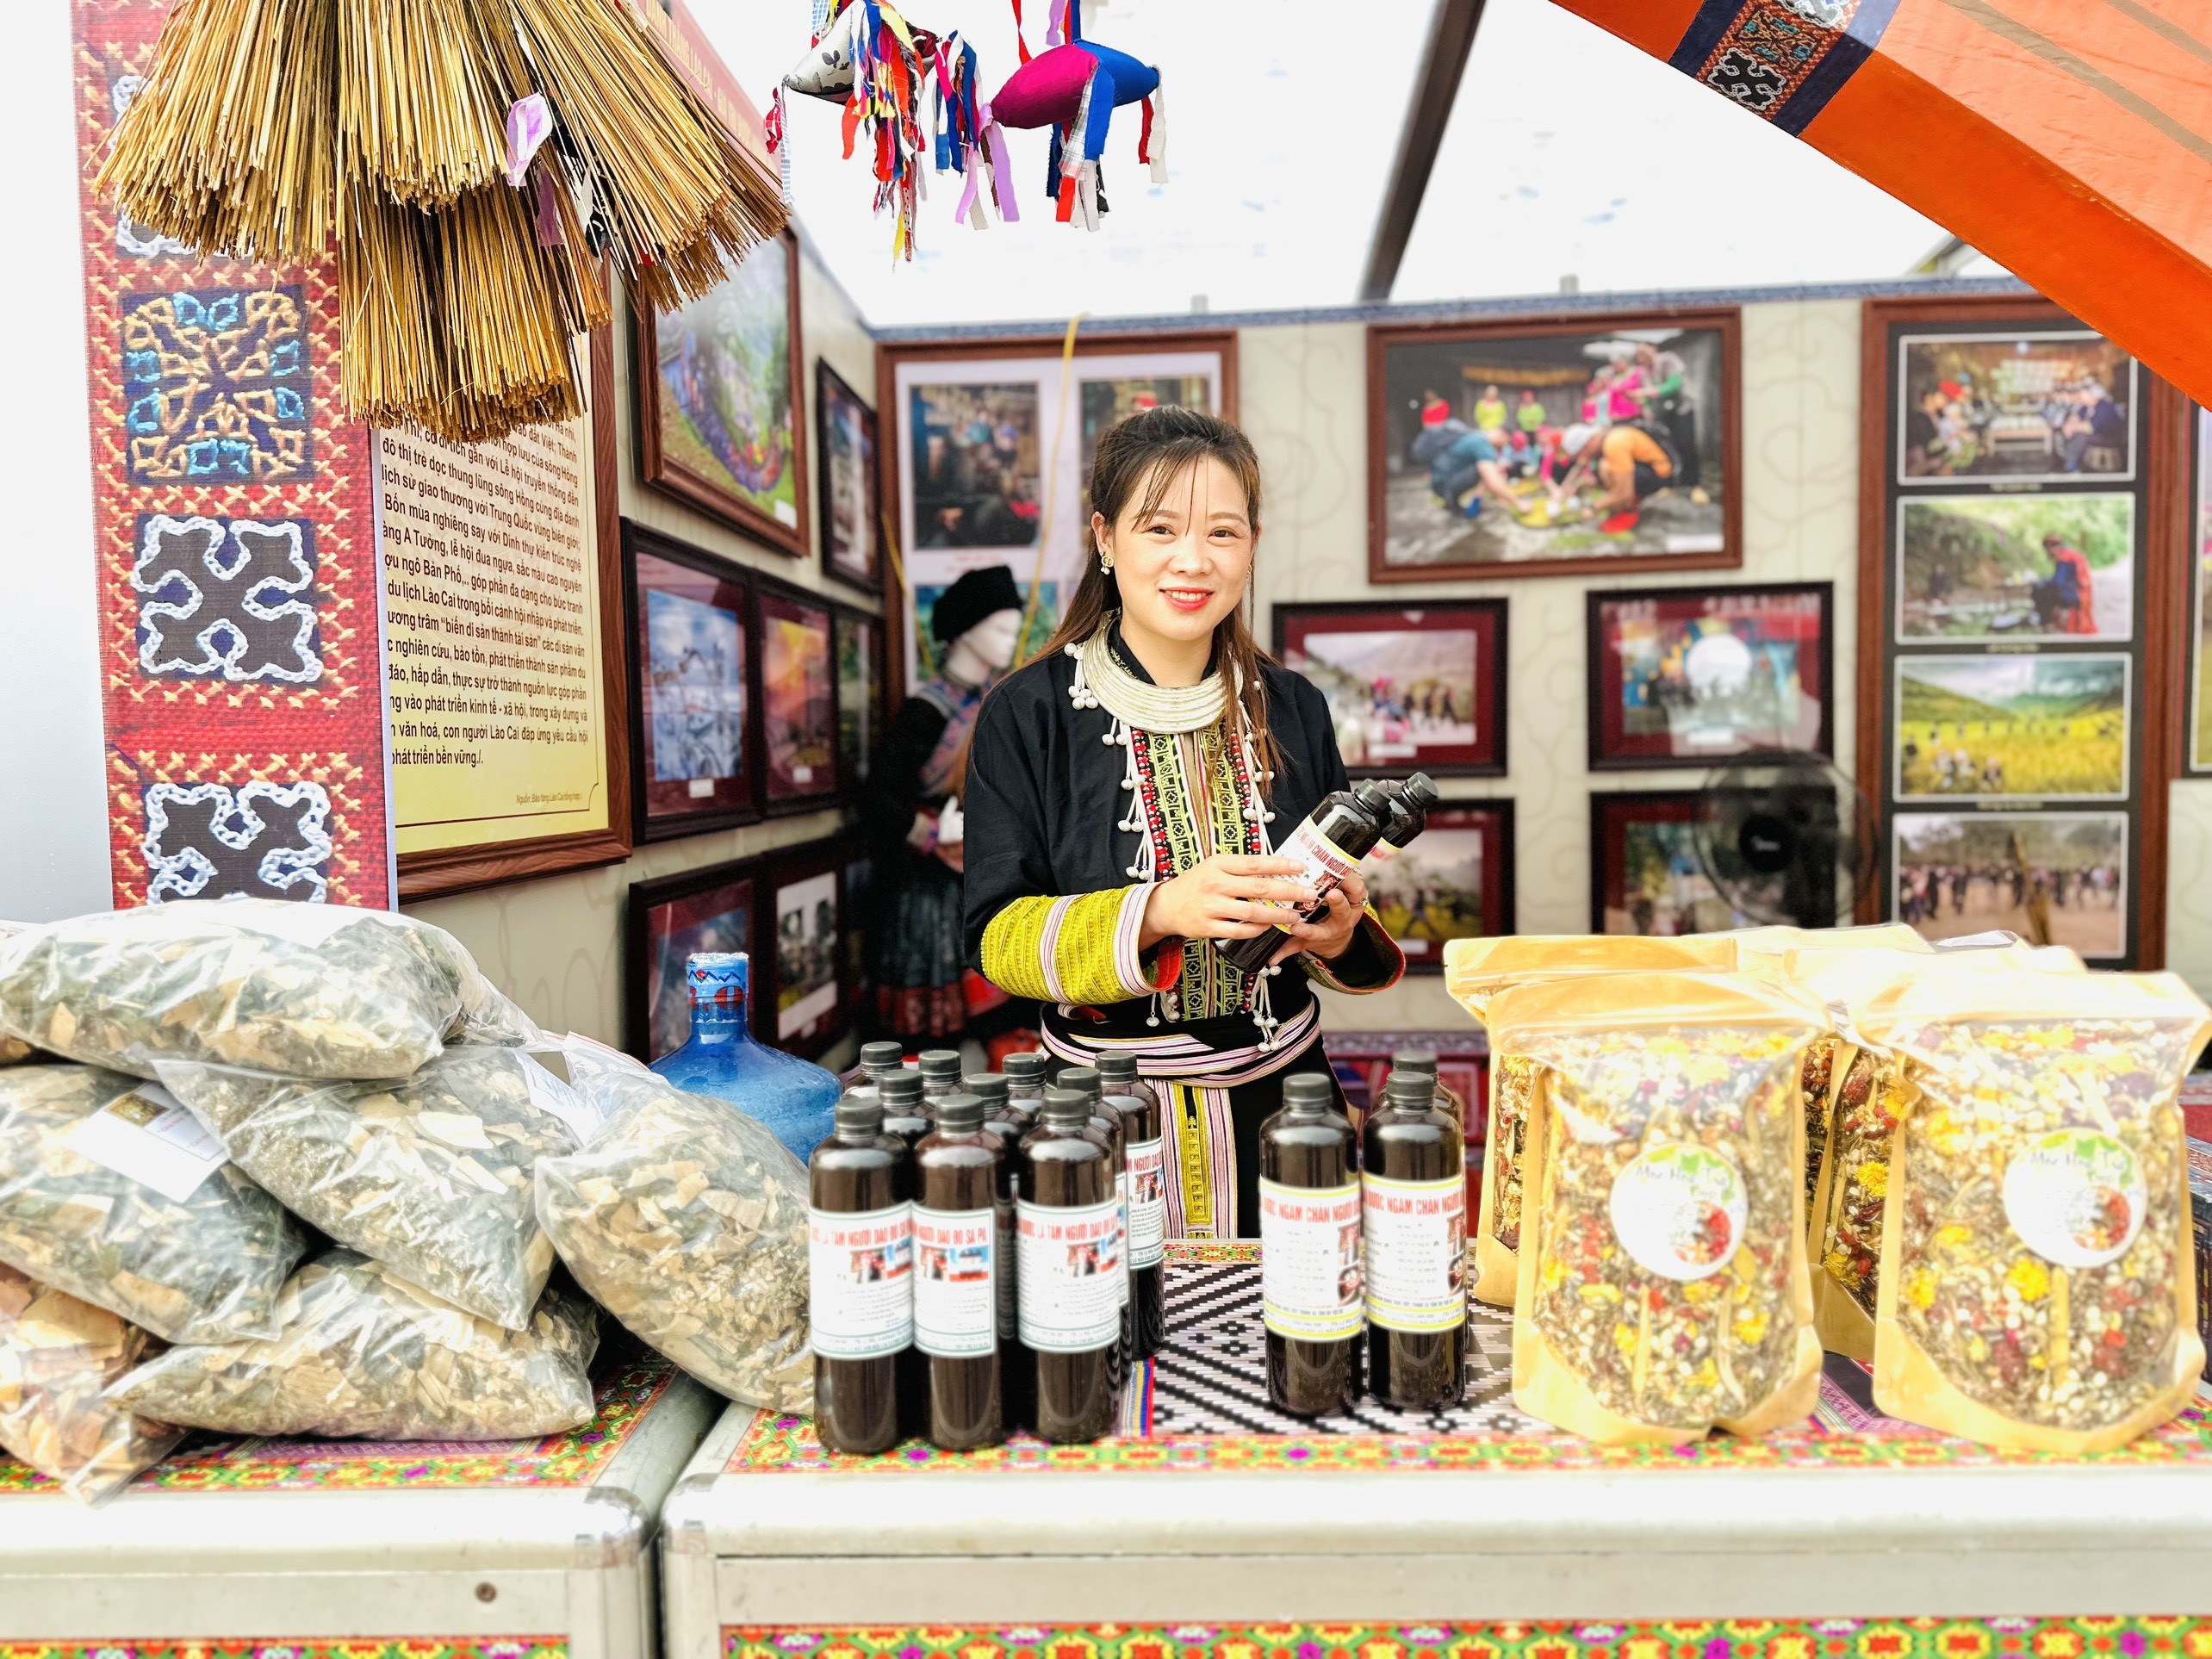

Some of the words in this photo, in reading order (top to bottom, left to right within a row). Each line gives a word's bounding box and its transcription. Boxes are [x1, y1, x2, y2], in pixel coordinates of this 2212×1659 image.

[383, 438, 395, 456] đô
[399, 443, 412, 466] thị
[413, 450, 426, 467] trẻ
[429, 456, 446, 476] dọc
[448, 463, 473, 488] thung
[475, 473, 493, 497] lũng
[494, 482, 513, 505] sông
[516, 488, 533, 513] Hồng
[536, 500, 551, 520] cùng
[486, 455, 499, 471] với
[500, 458, 508, 475] Lễ
[512, 463, 523, 484] hội
[525, 471, 546, 492] truyền
[548, 481, 566, 505] thống
[519, 444, 531, 462] lưu
[531, 452, 544, 469] của
[544, 459, 561, 480] sông
[562, 465, 578, 488] Hồng
[382, 463, 400, 485] lịch
[402, 472, 416, 490] sử
[418, 478, 438, 498] giao
[440, 486, 473, 514] thương
[475, 499, 488, 517] với
[489, 503, 512, 527] Trung
[513, 513, 532, 532] Quốc
[533, 521, 550, 542] vùng
[384, 492, 406, 514] Bốn
[409, 504, 430, 522] mùa
[433, 513, 469, 538] nghiêng
[470, 525, 485, 543] say
[488, 529, 500, 544] với
[503, 531, 520, 550] Dinh
[522, 539, 534, 558] thự
[536, 544, 550, 561] kiến
[402, 557, 421, 576] ngô
[423, 559, 442, 579] Bản
[471, 574, 487, 593] góp
[488, 575, 508, 594] phần
[510, 582, 519, 598] đa
[520, 585, 538, 606] dạng
[540, 591, 552, 606] cho
[553, 594, 566, 610] bức
[404, 527, 412, 544] A
[413, 529, 449, 557] Tưởng,
[450, 537, 458, 556] lễ
[460, 543, 474, 564] hội
[475, 549, 490, 566] đua
[493, 556, 515, 575] ngựa,
[517, 559, 531, 577] sắc
[531, 567, 545, 581] màu
[547, 573, 558, 586] cao
[560, 577, 582, 594] nguyên
[388, 579, 401, 597] du
[402, 581, 420, 603] lịch
[422, 586, 440, 605] Lào
[441, 590, 456, 607] Cai
[457, 594, 480, 617] trong
[481, 597, 494, 616] bối
[494, 603, 513, 619] cảnh
[514, 606, 525, 625] hội
[526, 611, 544, 630] nhập
[544, 615, 552, 629] và
[553, 617, 568, 633] phát
[388, 611, 415, 631] ương
[418, 612, 439, 631] trâm
[466, 622, 474, 637] di
[475, 624, 490, 639] sản
[491, 627, 513, 644] thành
[514, 631, 524, 646] tài
[543, 637, 554, 651] các
[395, 637, 429, 657] nghiên
[432, 643, 452, 662] cứu,
[454, 644, 469, 662] bảo
[472, 644, 488, 667] tồn,
[489, 651, 506, 668] phát
[508, 651, 525, 669] triển
[525, 656, 545, 673] thành
[547, 661, 558, 674] sản
[560, 661, 577, 679] phẩm
[411, 662, 429, 687] hấp
[431, 666, 450, 688] dẫn,
[452, 671, 473, 691] thực
[475, 676, 485, 692] sự
[487, 674, 499, 690] trở
[500, 677, 522, 693] thành
[523, 678, 545, 698] nguồn
[547, 682, 557, 699] lực
[558, 684, 570, 700] góp
[404, 693, 422, 710] vào
[425, 695, 445, 714] phát
[448, 693, 468, 712] triển
[470, 698, 488, 713] kinh
[489, 697, 497, 715] tế
[504, 701, 513, 716] xã
[514, 702, 528, 720] hội,
[530, 704, 548, 721] trong
[550, 705, 561, 722] xây
[399, 720, 417, 736] văn
[420, 721, 440, 740] hoá,
[443, 726, 459, 738] con
[463, 724, 488, 743] người
[490, 724, 505, 740] Lào
[506, 725, 519, 740] Cai
[521, 726, 535, 743] đáp
[537, 727, 550, 744] ứng
[552, 728, 564, 744] yêu
[413, 744, 434, 765] triển
[436, 745, 452, 764] bền
